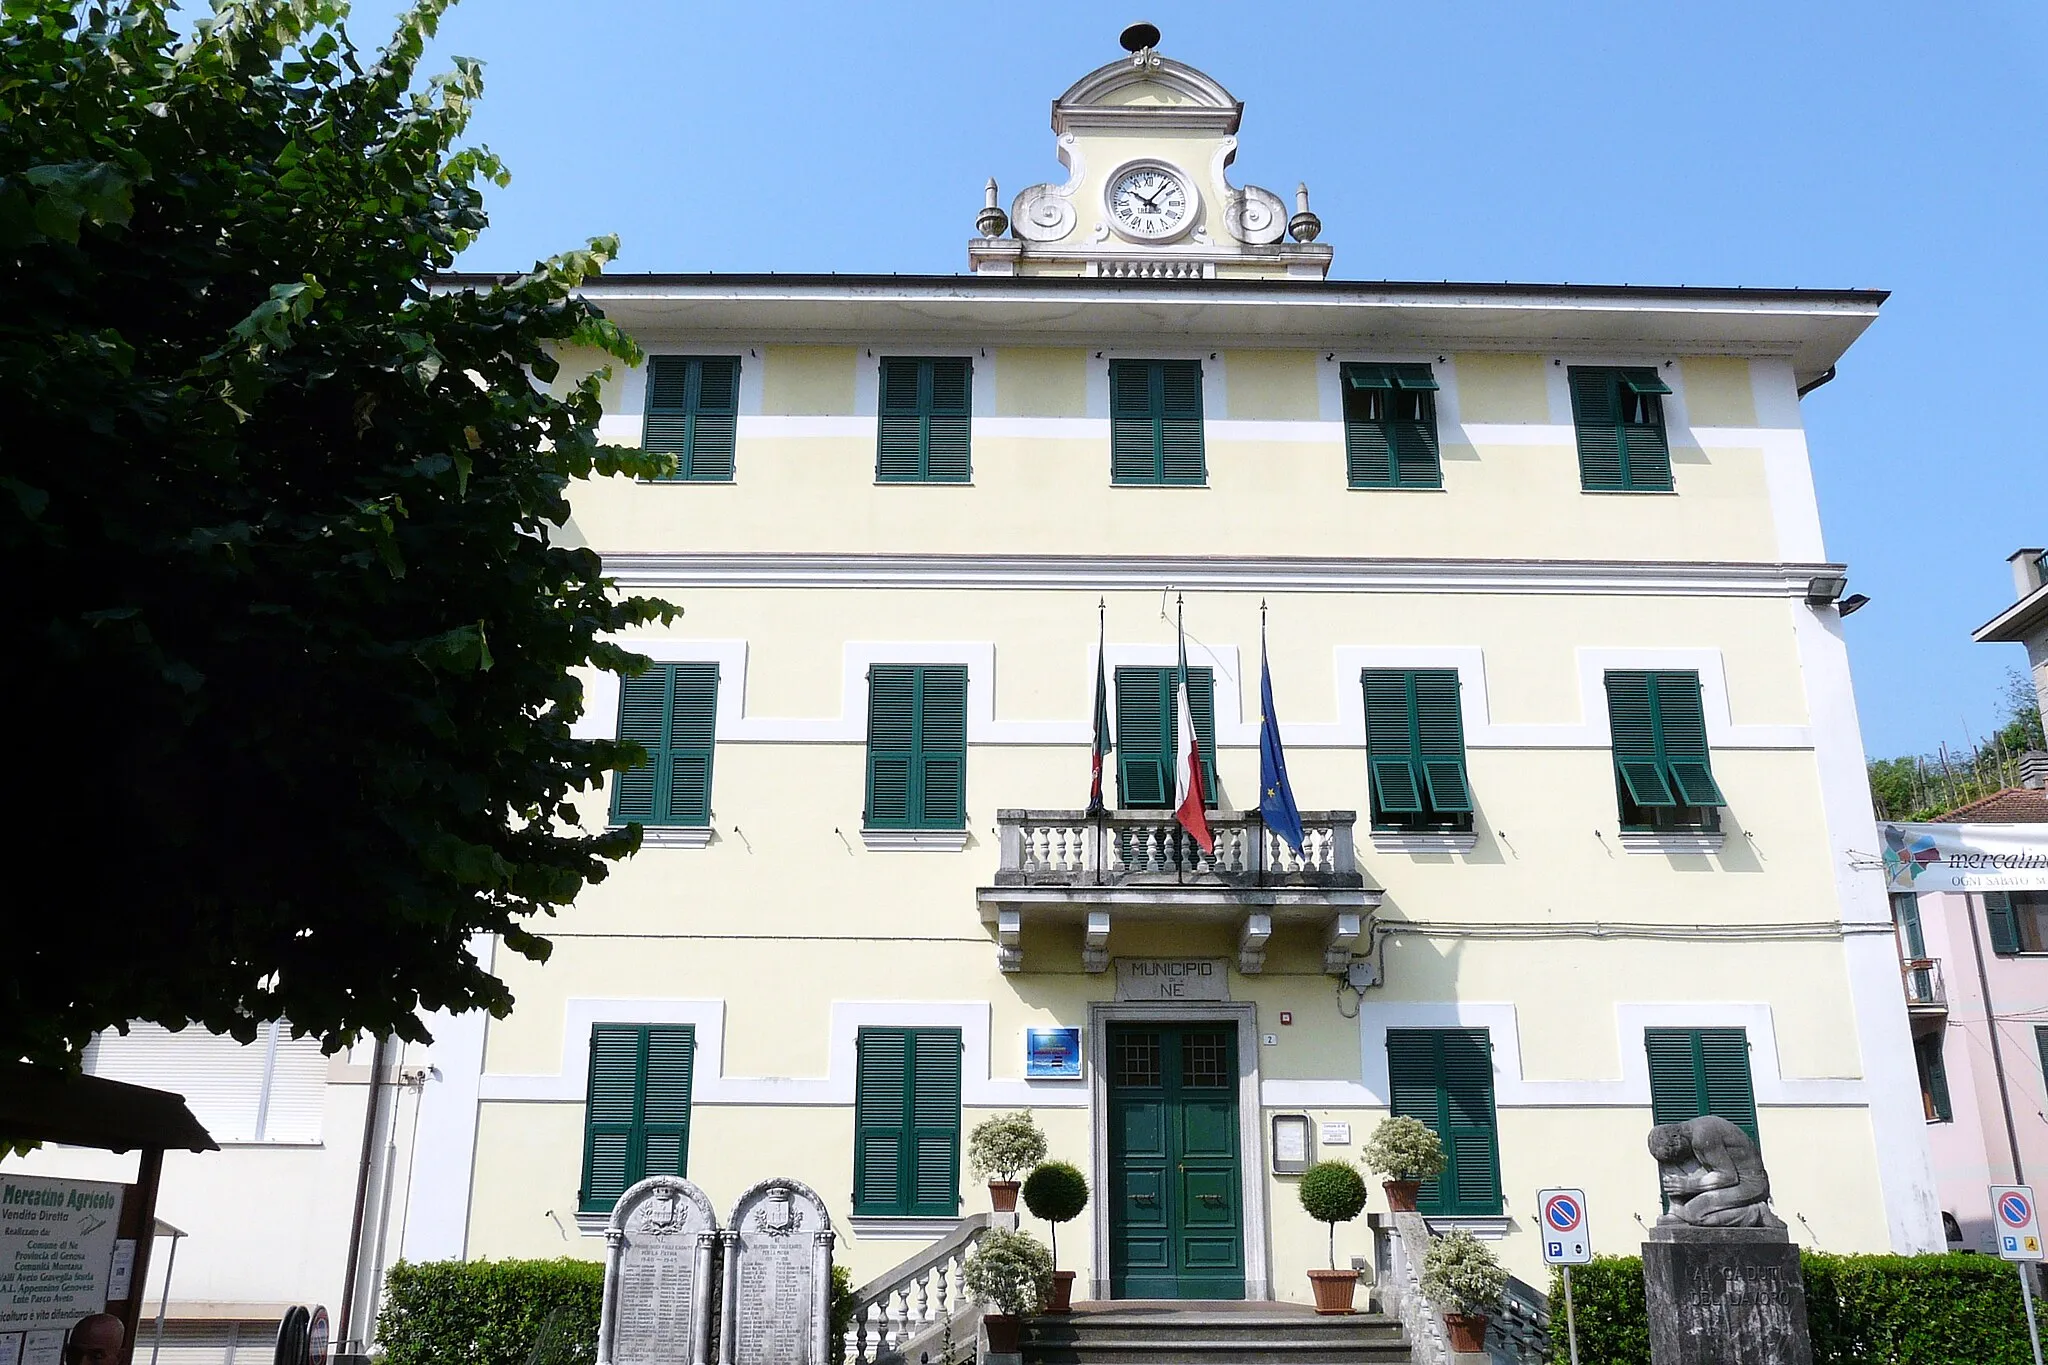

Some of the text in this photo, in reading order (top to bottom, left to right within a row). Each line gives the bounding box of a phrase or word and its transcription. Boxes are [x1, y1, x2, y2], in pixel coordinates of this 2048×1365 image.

[1952, 876, 1981, 886] OGNI
[1986, 876, 2028, 886] SABATO
[1132, 963, 1212, 976] MUNICIPIO
[2, 1184, 115, 1212] Mercatino Agricolo
[2, 1208, 69, 1221] Vendita Diretta
[27, 1240, 78, 1249] Comune di Ne
[2005, 1238, 2013, 1250] P
[1551, 1244, 1560, 1255] P
[15, 1251, 49, 1260] Provincia
[50, 1252, 58, 1260] di
[52, 1262, 82, 1270] Montana
[1721, 1266, 1785, 1282] CADUTI
[61, 1283, 94, 1292] Genovese
[53, 1294, 74, 1302] Aveto
[36, 1310, 50, 1320] vita
